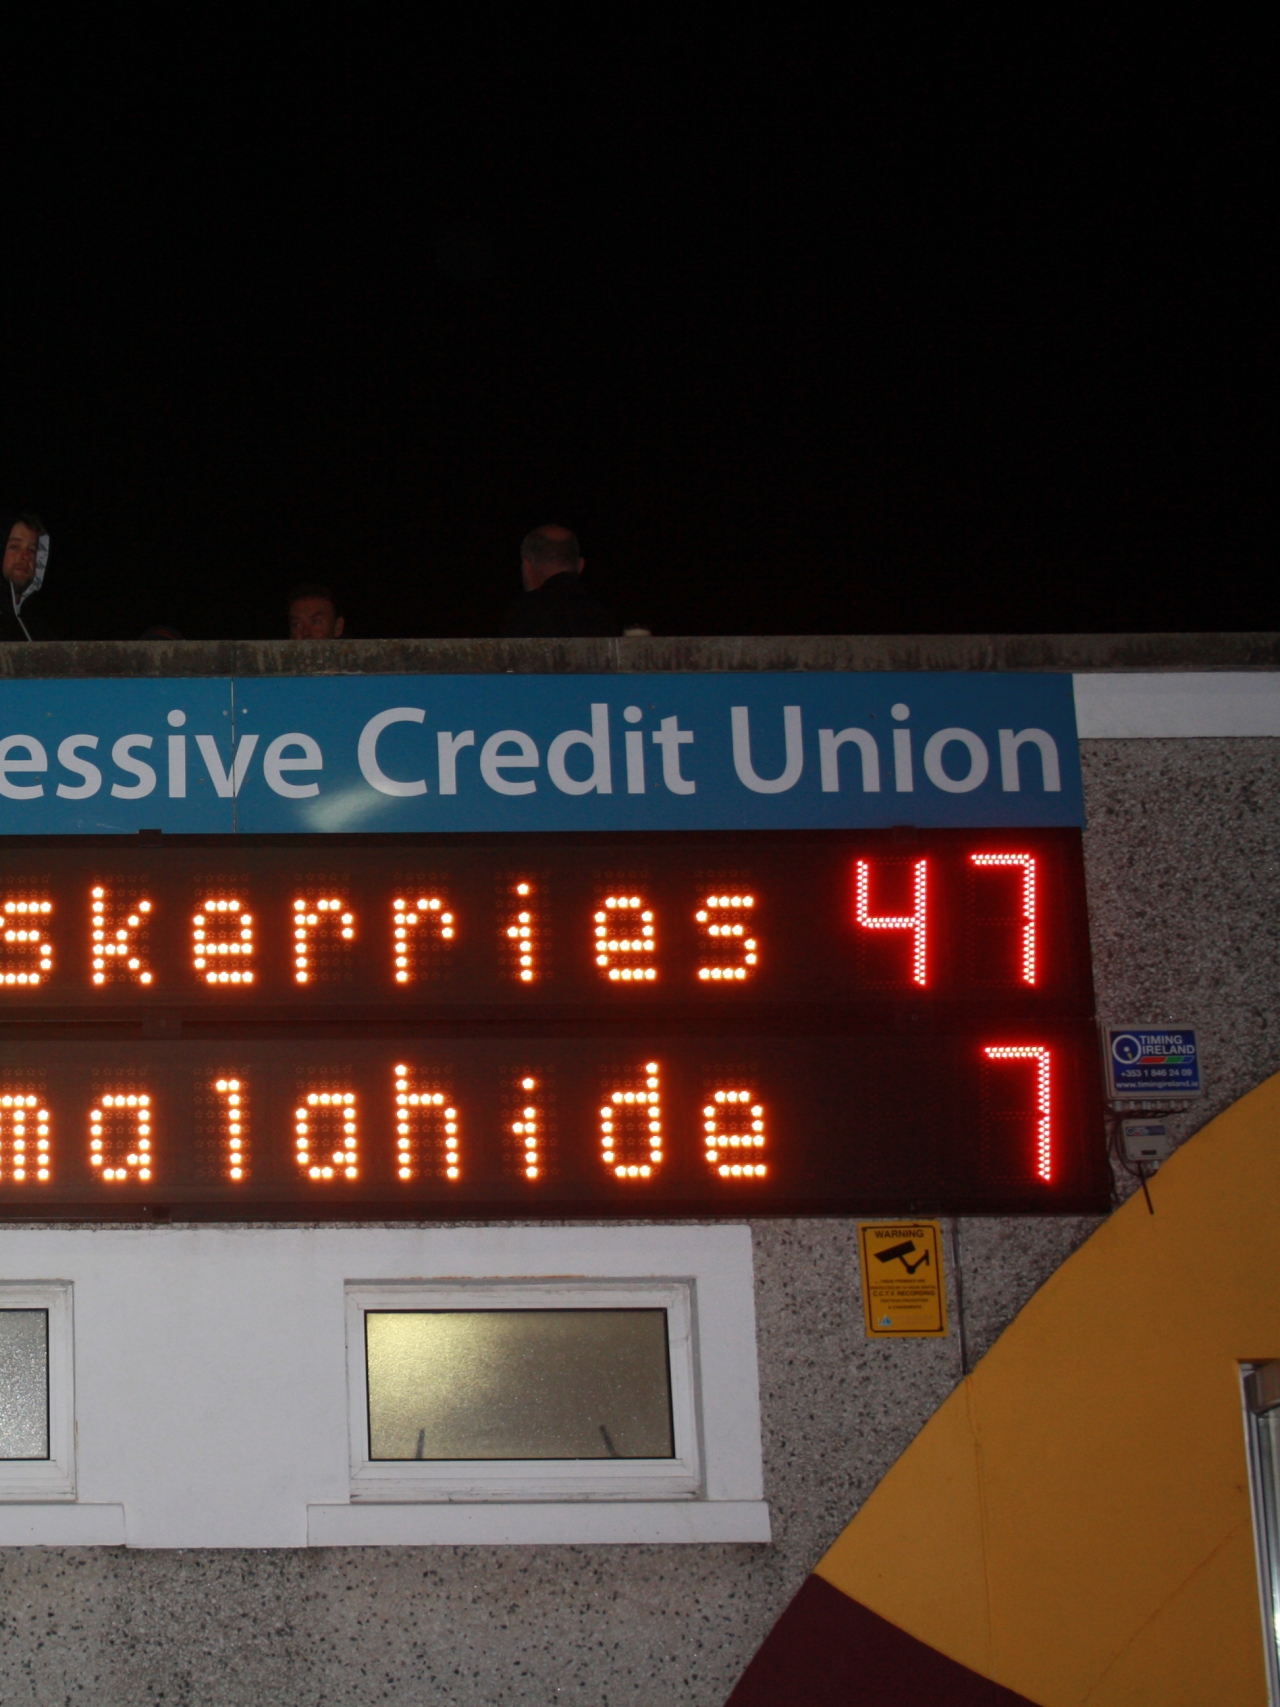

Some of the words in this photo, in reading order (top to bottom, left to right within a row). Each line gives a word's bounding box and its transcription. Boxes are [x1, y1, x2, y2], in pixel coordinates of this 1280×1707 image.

[357, 703, 696, 797] Credit
[730, 703, 1062, 795] Union
[856, 853, 1036, 987] 47
[1139, 1035, 1182, 1045] TIMING
[1142, 1045, 1195, 1054] IRELAND
[1120, 1069, 1142, 1077] +353
[1116, 1080, 1198, 1088] www.timingireland.ie
[983, 1046, 1051, 1182] 7
[874, 1229, 924, 1238] WARNING
